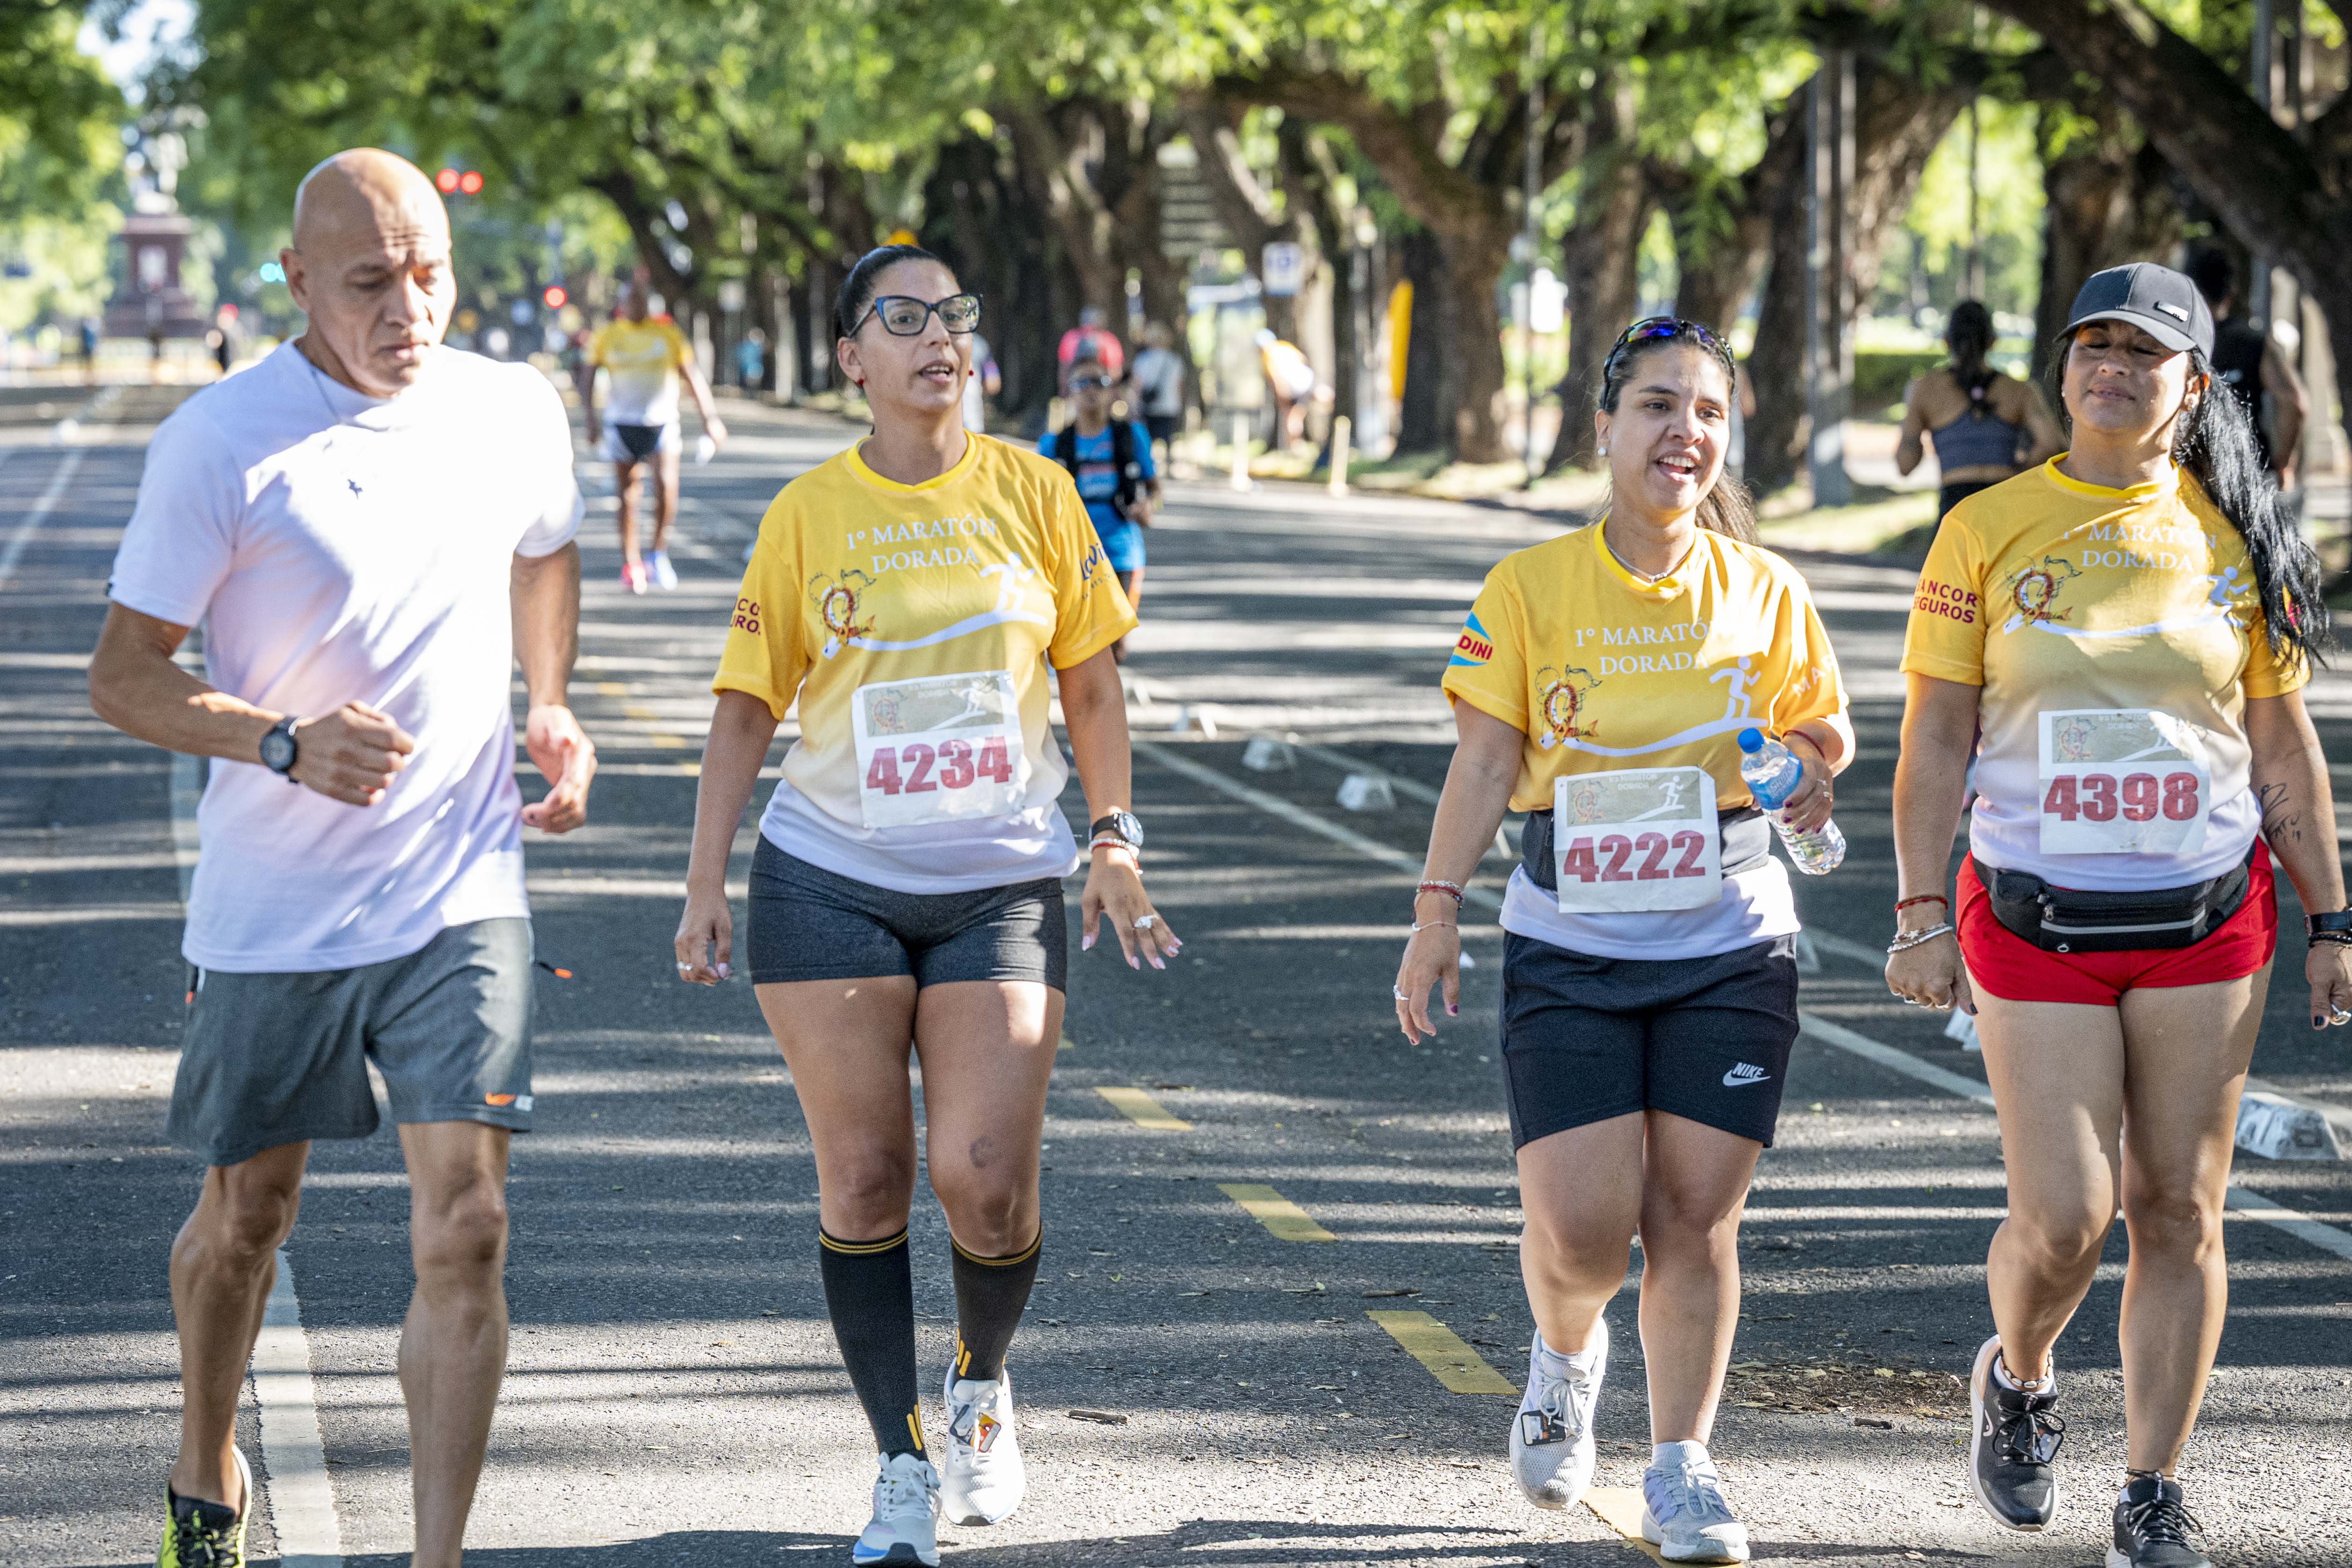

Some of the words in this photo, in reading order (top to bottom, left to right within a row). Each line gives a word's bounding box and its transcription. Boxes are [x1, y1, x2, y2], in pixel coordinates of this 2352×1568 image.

[871, 513, 996, 546] MARATÓN
[871, 546, 980, 574] DORADA
[2082, 550, 2194, 572] DORADA
[1602, 617, 1711, 646] MARATÓ
[1458, 634, 1493, 660] DINI
[1599, 651, 1709, 675] DORADA
[866, 736, 1012, 796] 4234
[2043, 772, 2199, 822] 4398
[1563, 830, 1706, 882] 4222
[1732, 1062, 1765, 1079] NIKE
